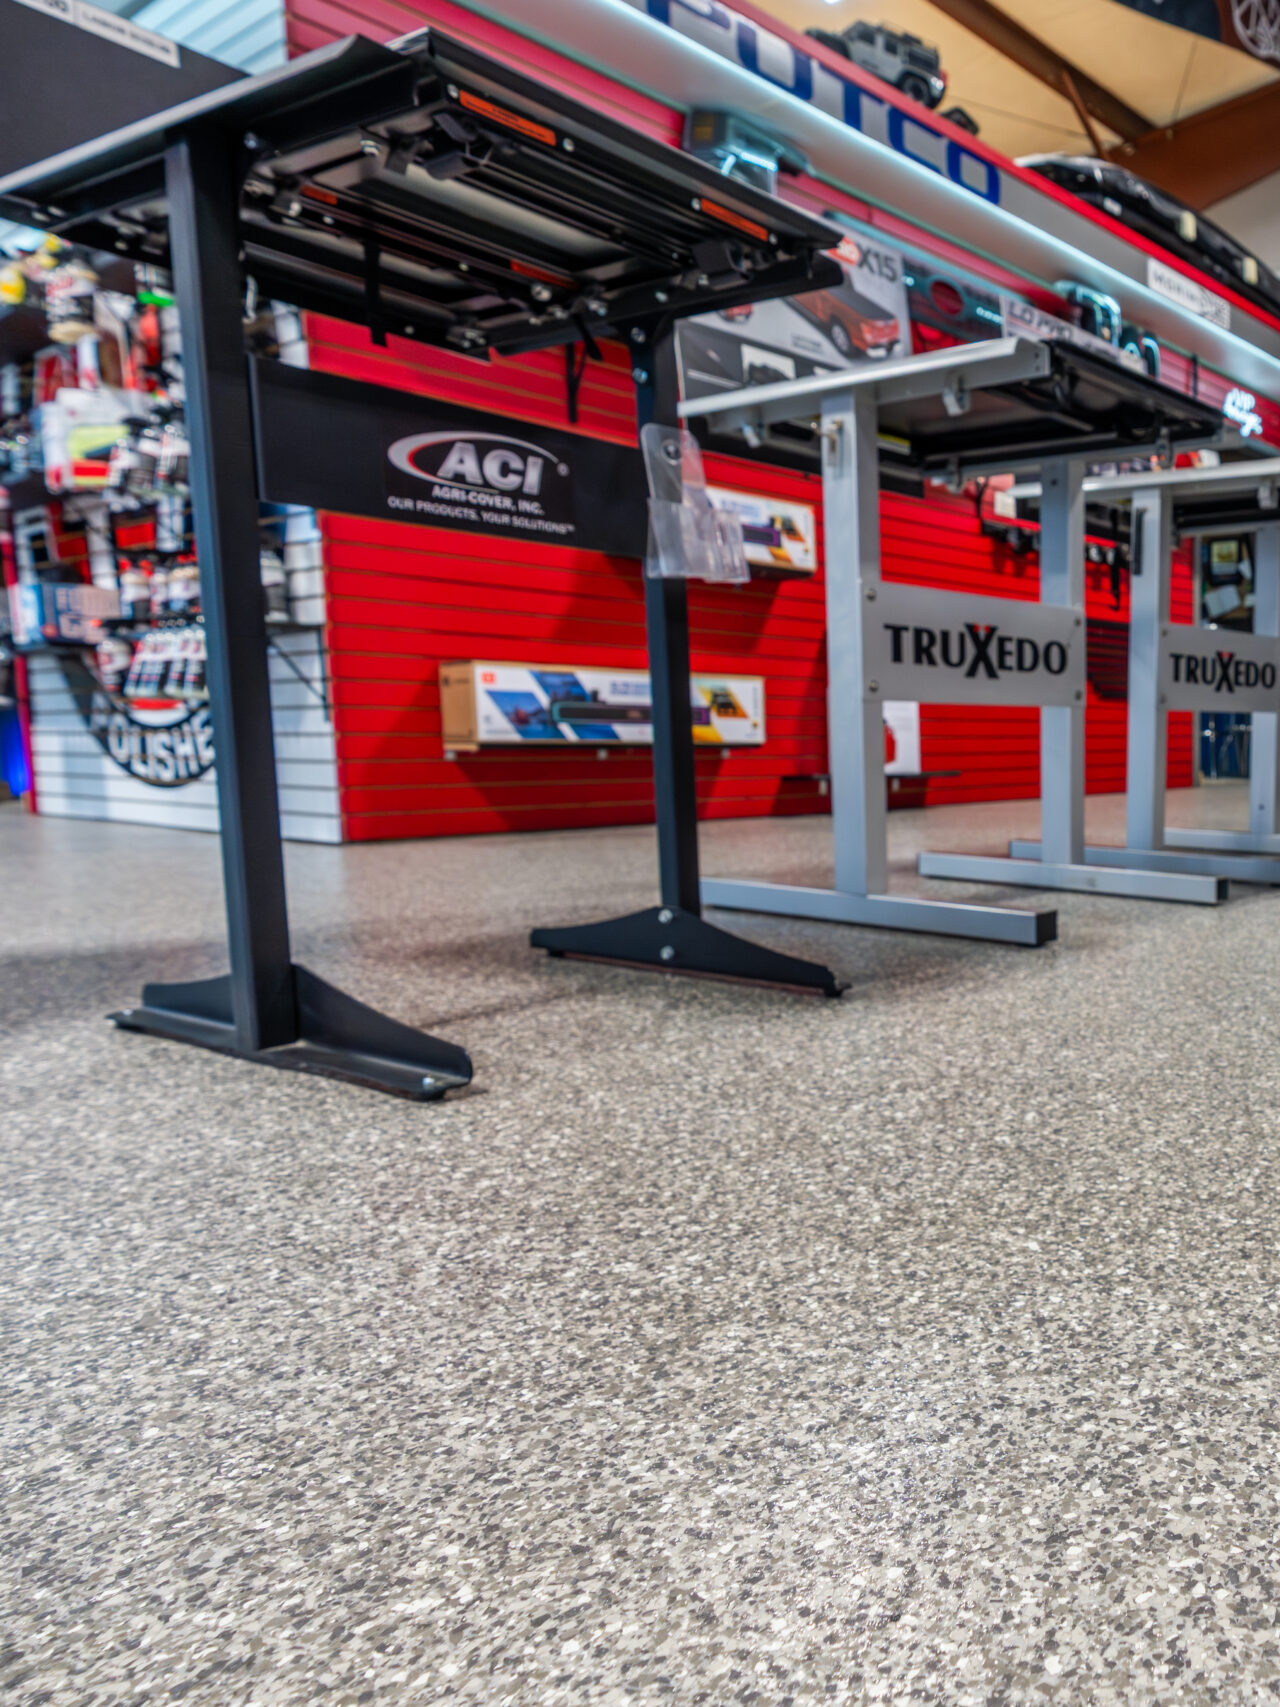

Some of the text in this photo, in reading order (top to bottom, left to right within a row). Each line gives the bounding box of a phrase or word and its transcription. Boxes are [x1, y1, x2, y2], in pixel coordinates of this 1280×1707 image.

[437, 441, 543, 495] ACI
[387, 495, 415, 512] OUR
[481, 510, 511, 526] YOUR
[884, 623, 1068, 680] TRUXEDO
[1169, 651, 1277, 694] TRUXEDO
